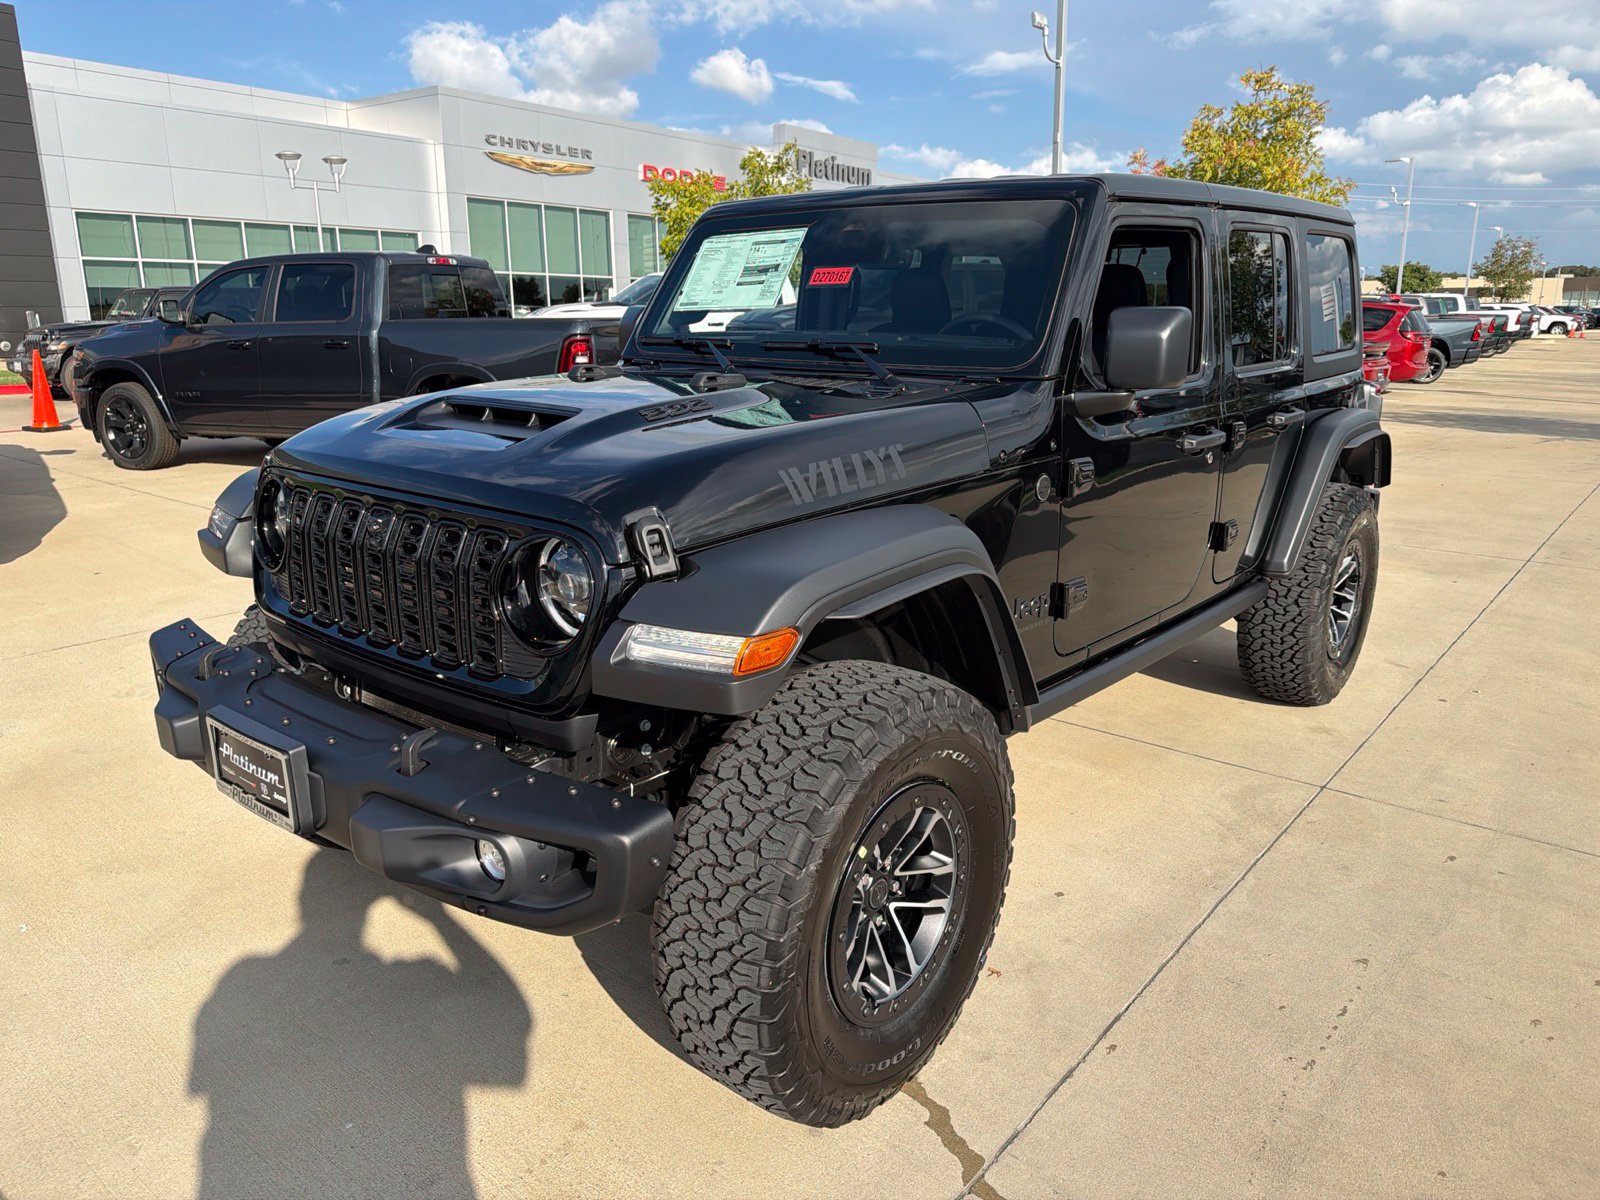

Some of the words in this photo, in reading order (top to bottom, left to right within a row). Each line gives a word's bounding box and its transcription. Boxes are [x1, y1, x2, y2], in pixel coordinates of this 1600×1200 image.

[484, 134, 593, 160] CHRYSLER
[642, 163, 727, 191] DODE
[796, 150, 872, 186] Platinum
[812, 271, 850, 283] D270167
[219, 742, 284, 789] Platinum
